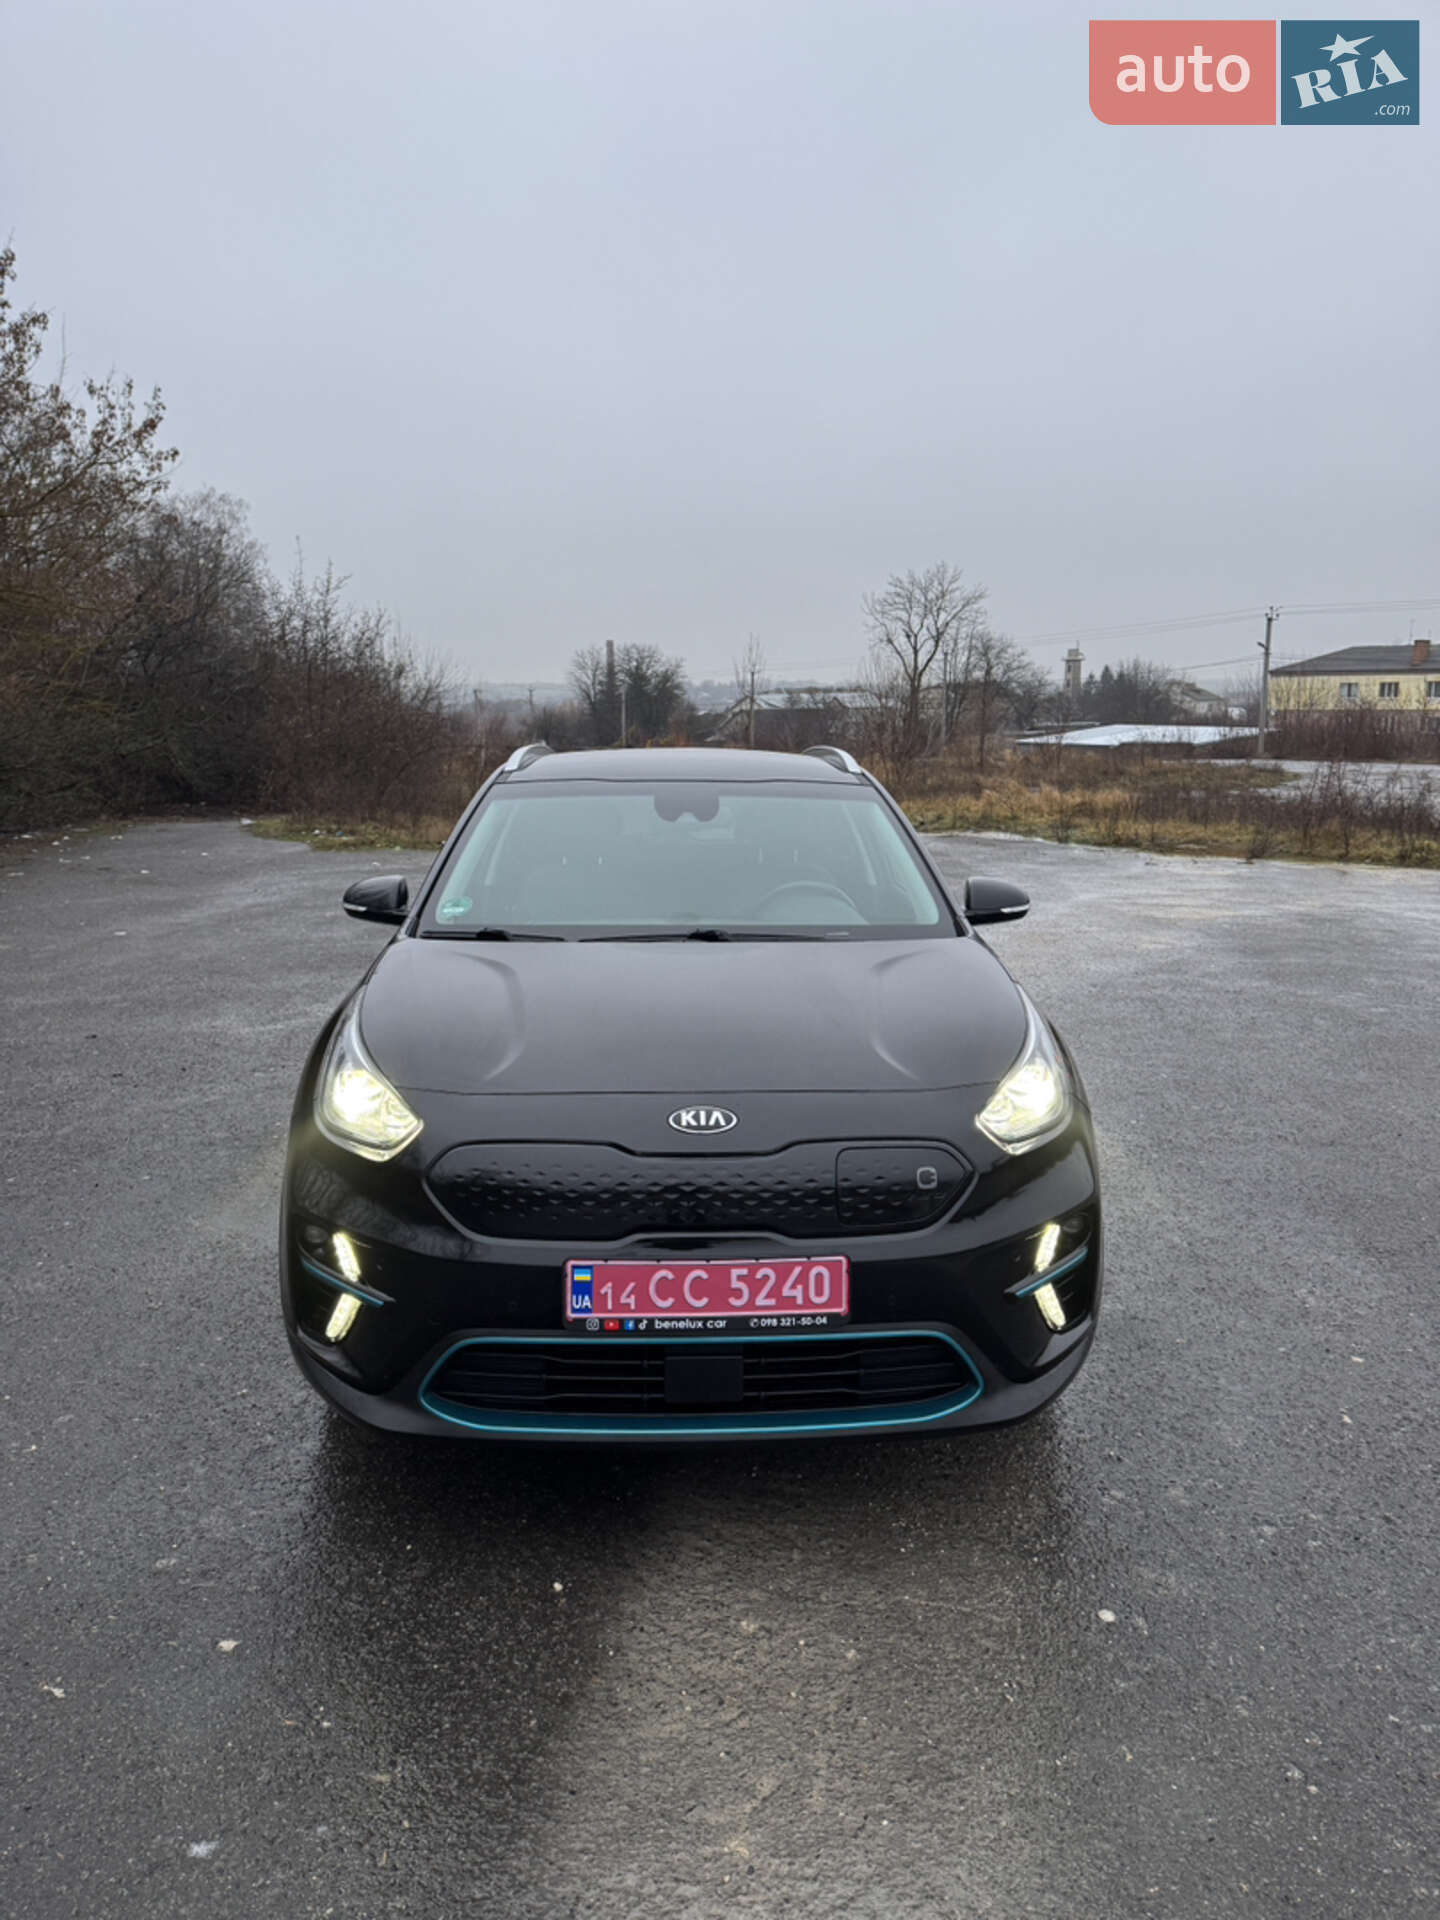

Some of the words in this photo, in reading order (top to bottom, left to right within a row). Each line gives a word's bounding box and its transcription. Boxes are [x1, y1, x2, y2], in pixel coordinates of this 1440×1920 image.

[681, 1110, 726, 1126] KIA
[599, 1282, 637, 1310] 14
[648, 1269, 710, 1308] CC
[728, 1265, 831, 1307] 5240
[572, 1295, 592, 1309] UA
[654, 1318, 703, 1329] benelux
[706, 1319, 727, 1329] car
